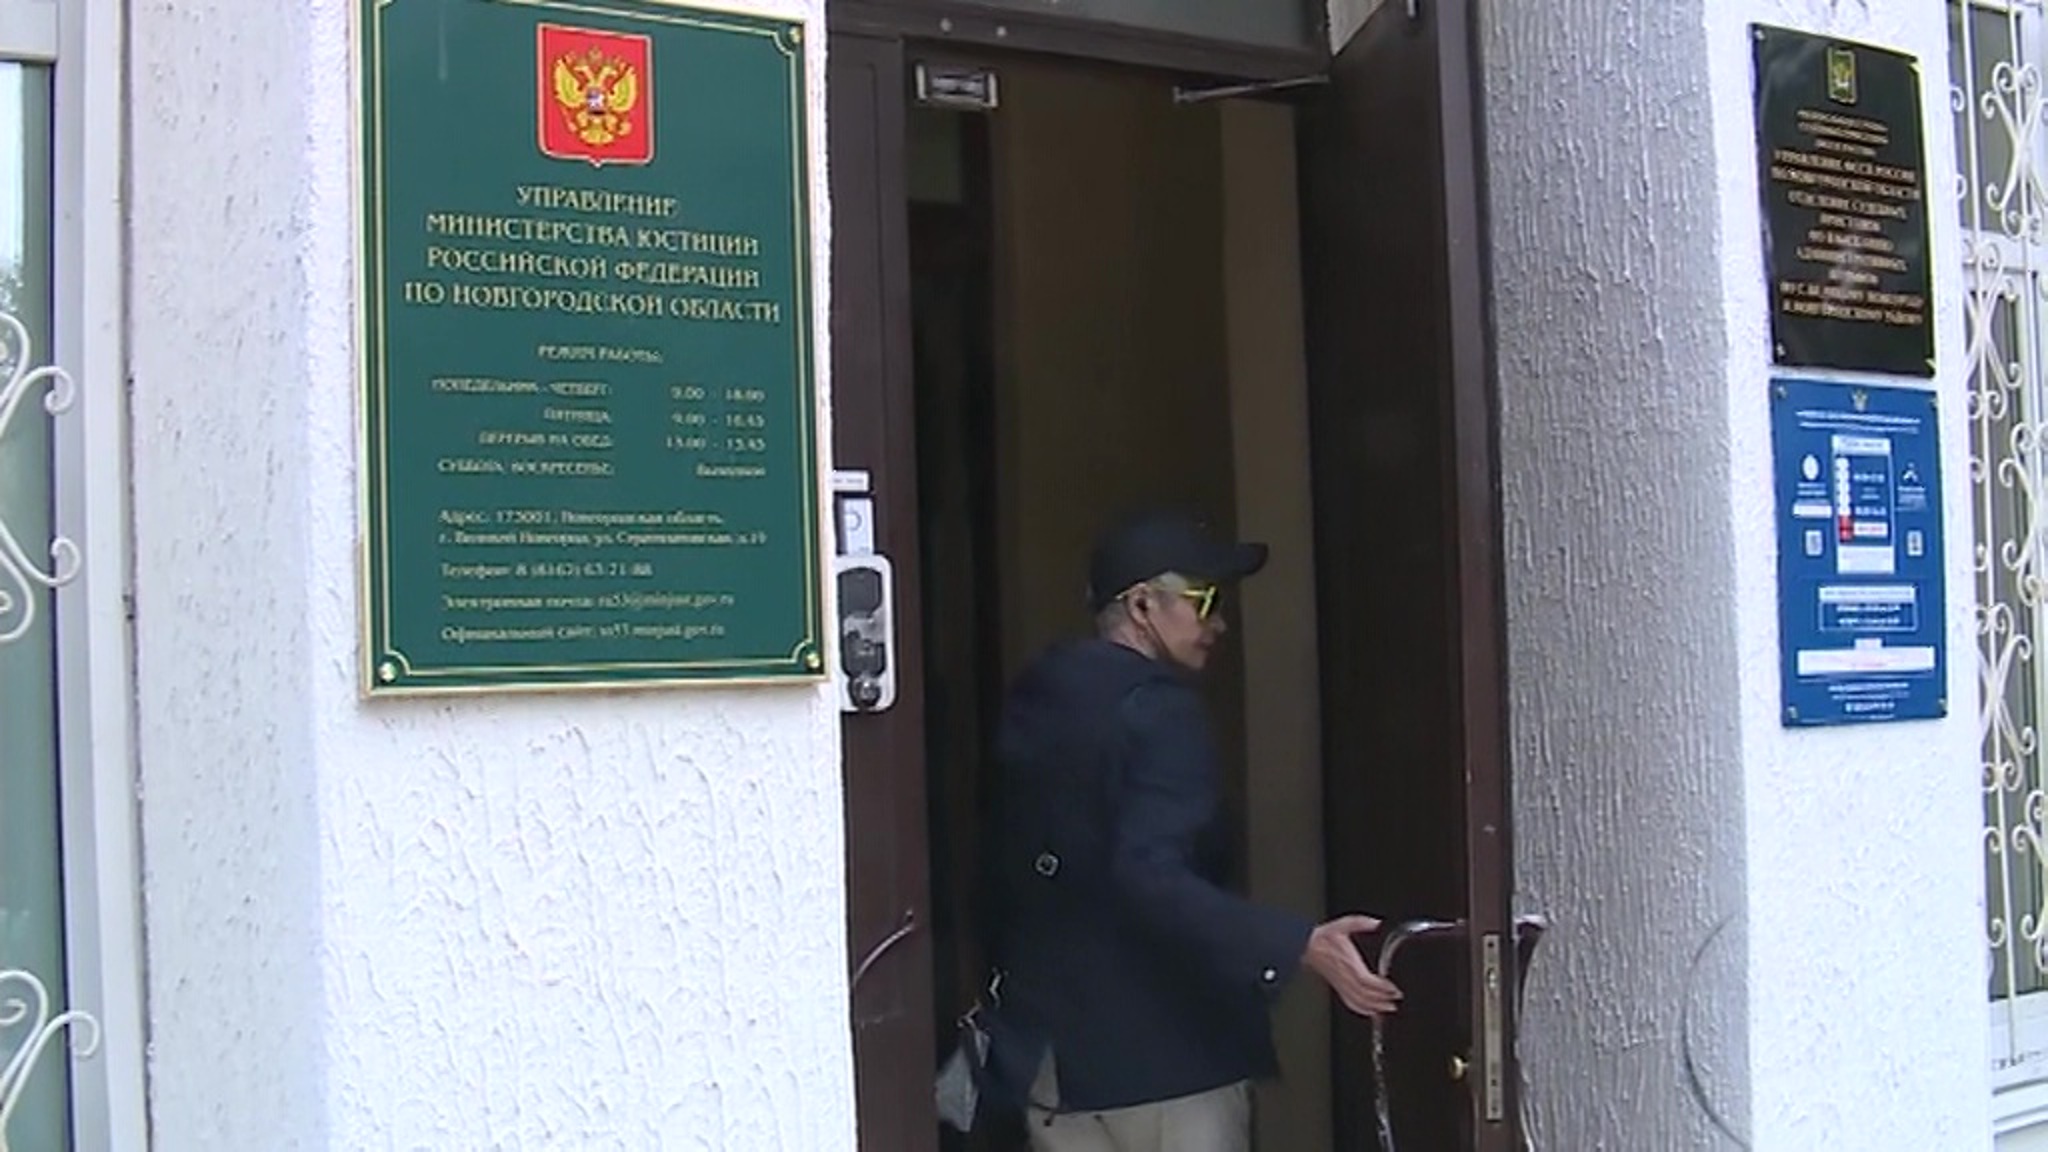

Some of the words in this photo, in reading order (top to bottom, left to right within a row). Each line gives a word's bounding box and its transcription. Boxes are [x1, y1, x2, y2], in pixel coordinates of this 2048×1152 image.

[517, 186, 678, 217] УПРАВЛЕНИЕ
[426, 213, 630, 248] МИНИСТЕРСТВА
[636, 229, 759, 256] ЮСТИЦИИ
[427, 246, 607, 278] РОССИЙСКОЙ
[615, 260, 760, 288] ФЕДЕРАЦИИ
[405, 282, 444, 304] ПО
[452, 285, 663, 317] НОВГОРОДСКОЙ
[670, 299, 780, 323] ОБЛАСТИ
